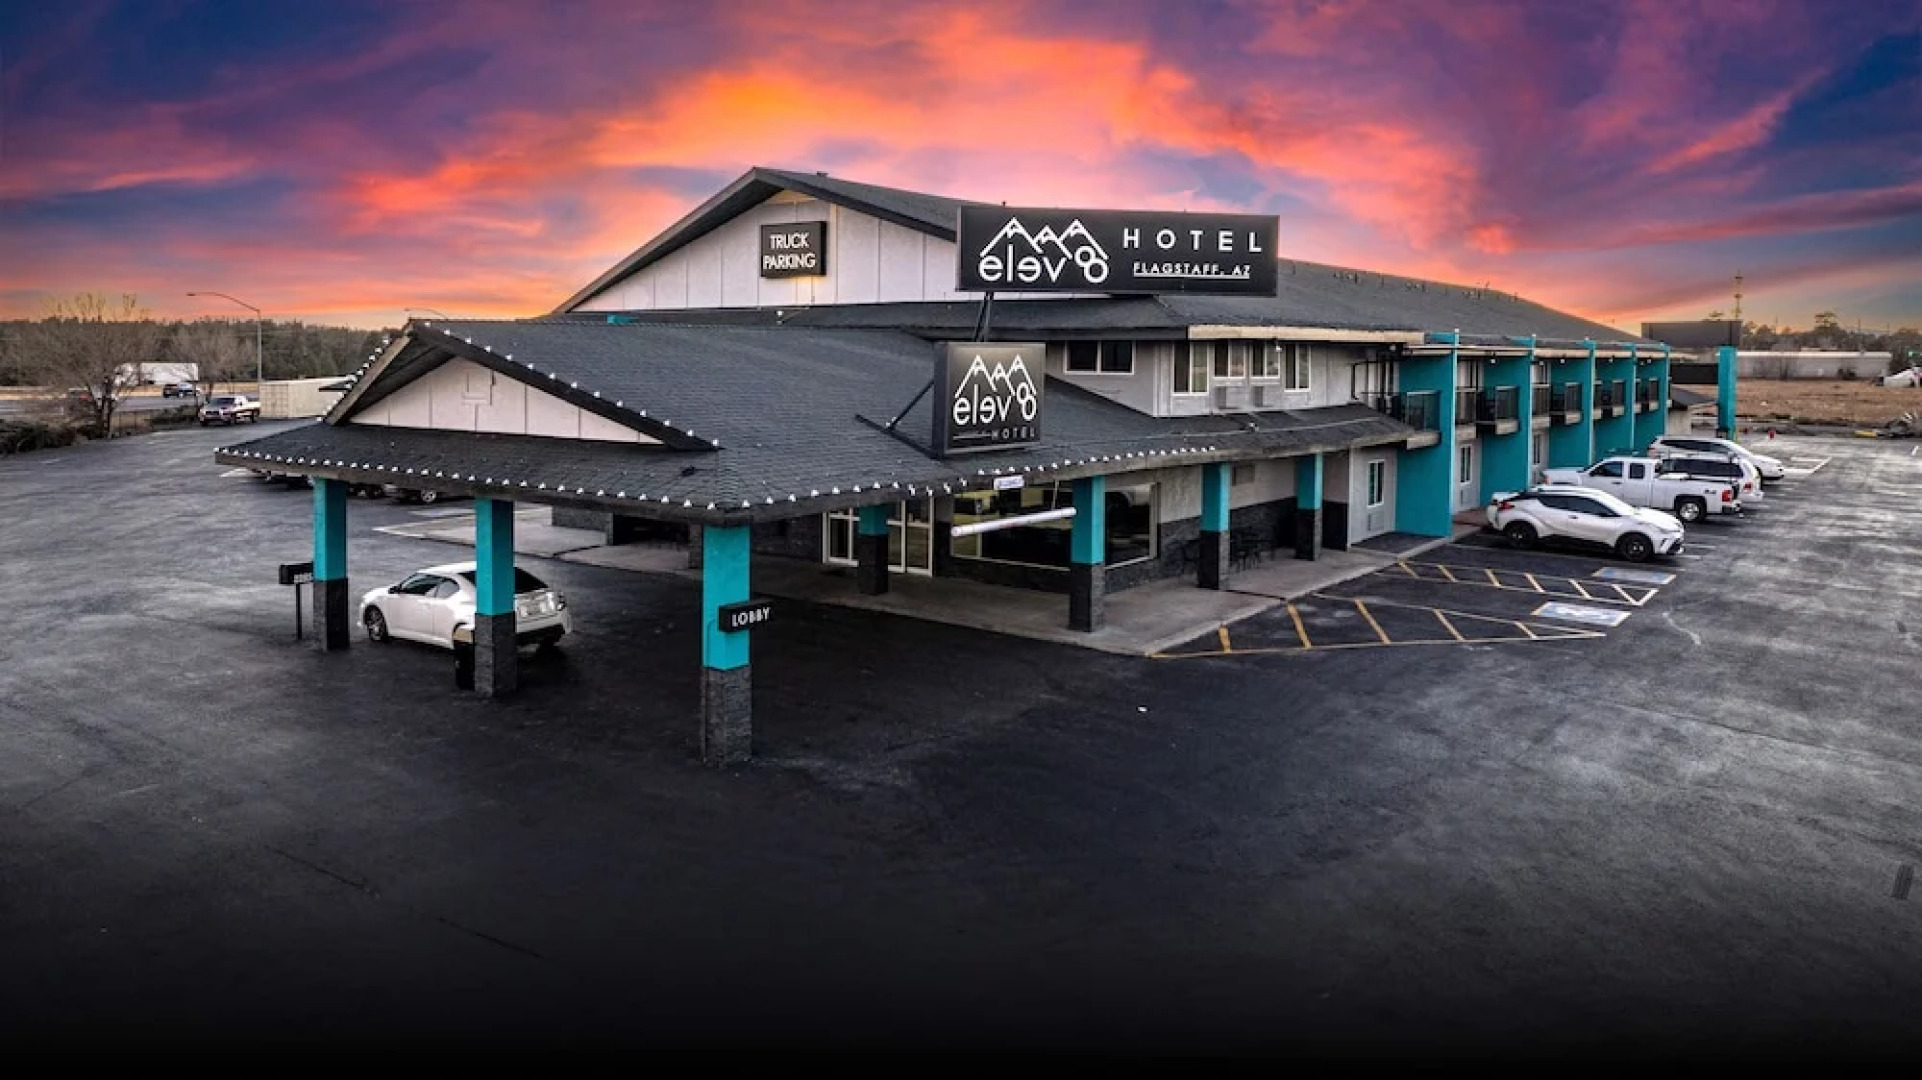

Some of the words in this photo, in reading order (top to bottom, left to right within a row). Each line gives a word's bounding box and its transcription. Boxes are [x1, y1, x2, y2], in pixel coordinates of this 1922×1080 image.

[770, 232, 810, 249] TRUCK
[1123, 228, 1262, 252] HOTEL
[763, 253, 816, 270] PARKING
[1232, 264, 1251, 276] AZ
[991, 426, 1035, 440] HOTEL
[731, 607, 771, 627] LOBBY
